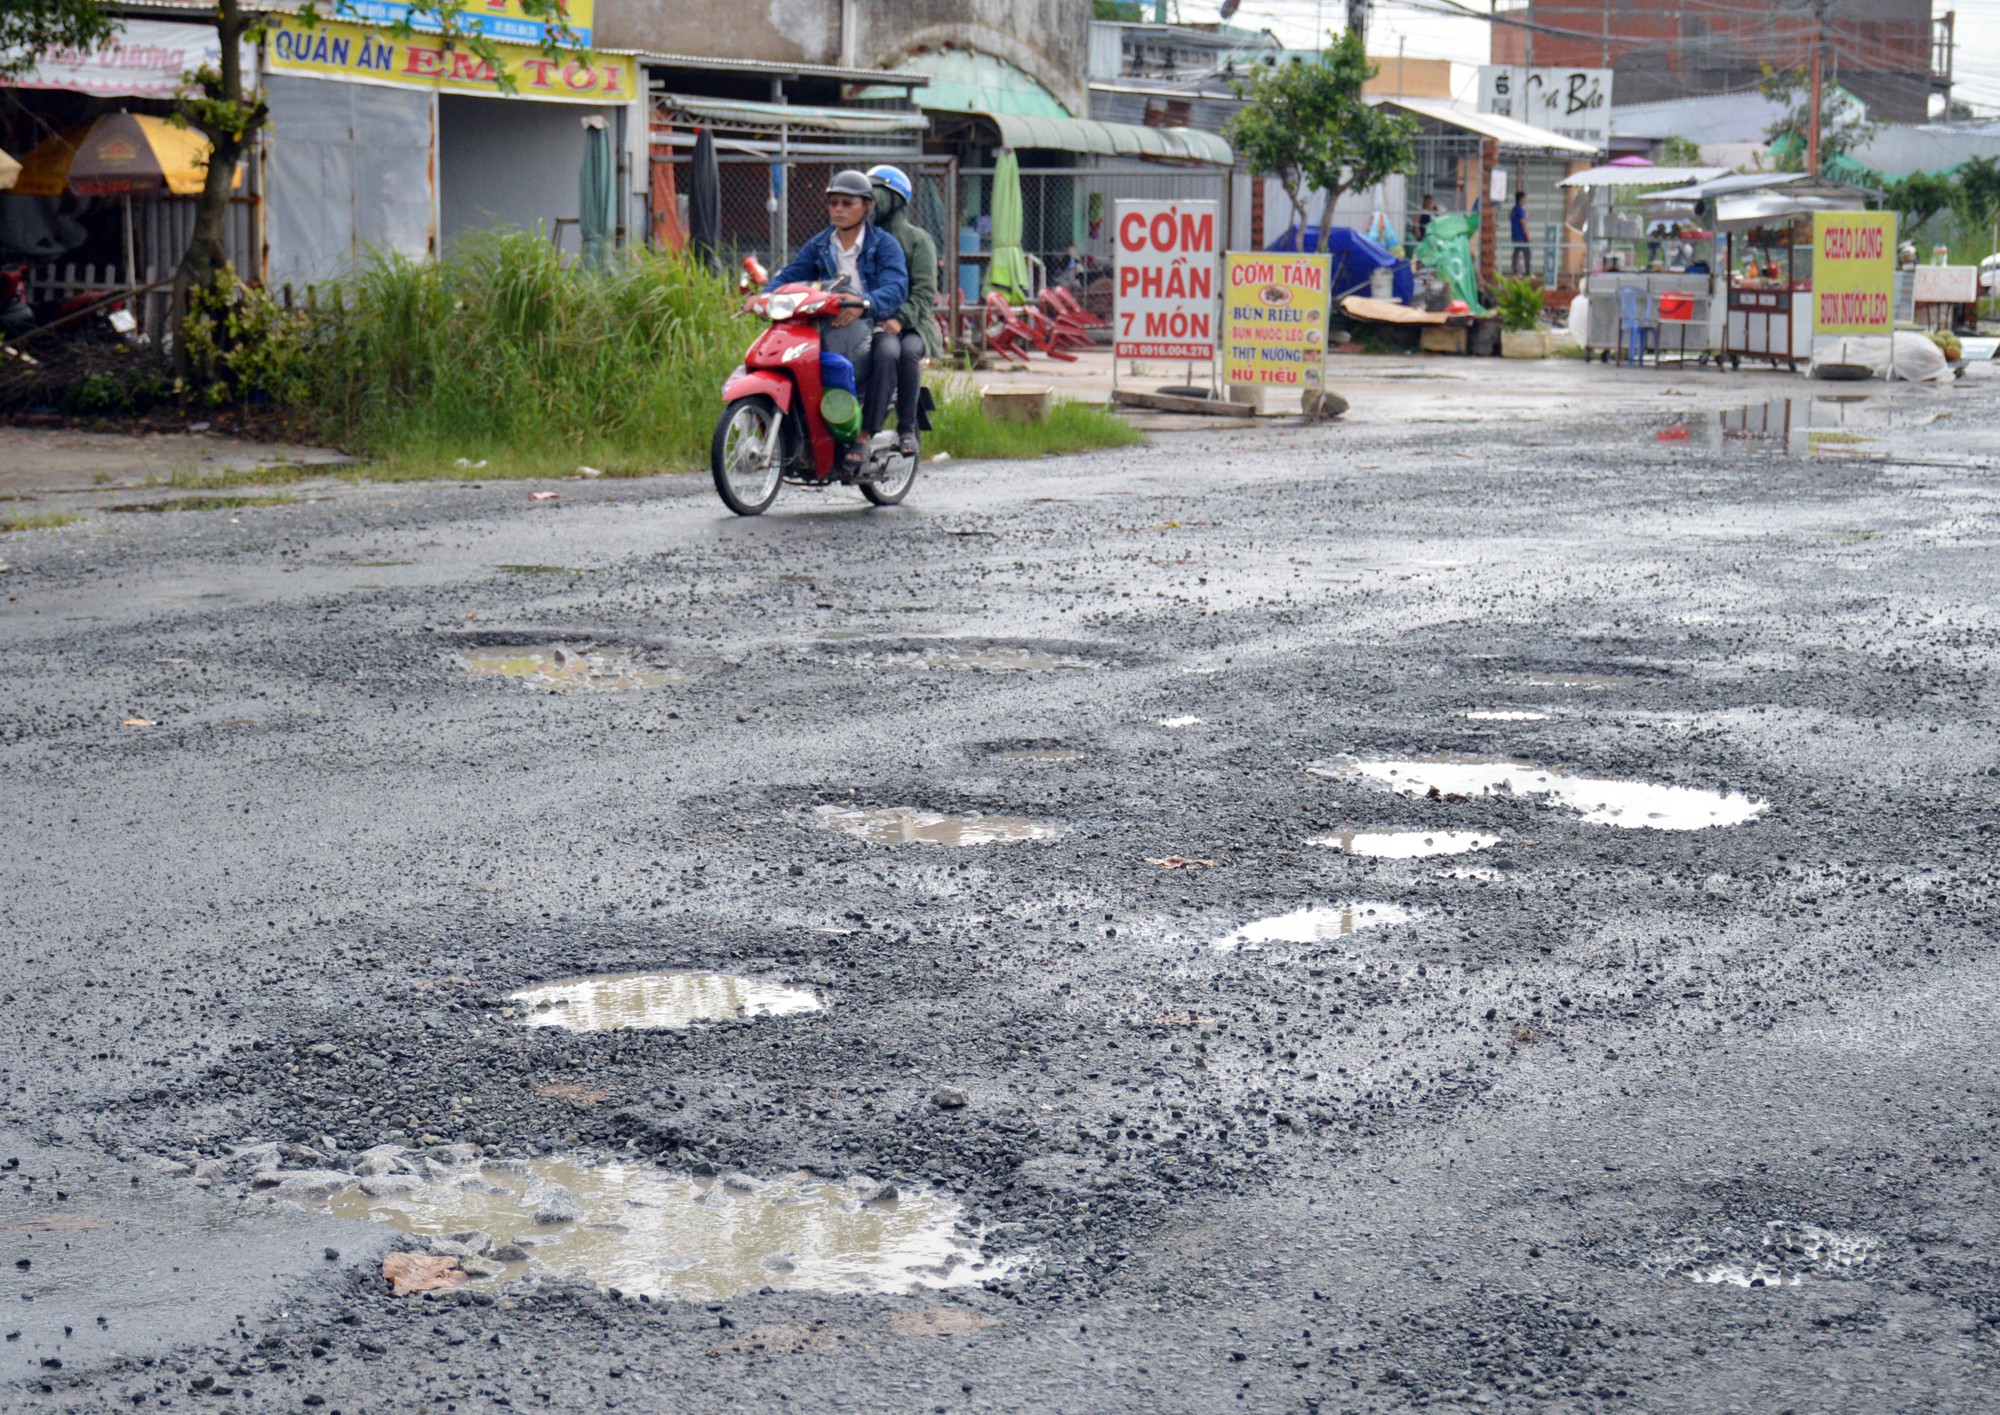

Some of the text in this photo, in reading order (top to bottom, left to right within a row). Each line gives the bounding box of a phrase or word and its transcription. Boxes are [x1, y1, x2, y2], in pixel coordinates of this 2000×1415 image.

[275, 28, 350, 66] QUÁN
[357, 34, 394, 71] ĂN
[402, 46, 500, 81] EM
[1119, 205, 1213, 252] CƠM
[1120, 256, 1211, 299] PHẦN
[1231, 259, 1322, 291] CƠM TẤM
[1120, 305, 1209, 338] 7 MÓN
[1233, 304, 1264, 321] BÚN
[1232, 346, 1257, 363] THỊT
[1231, 363, 1254, 381] HỦ
